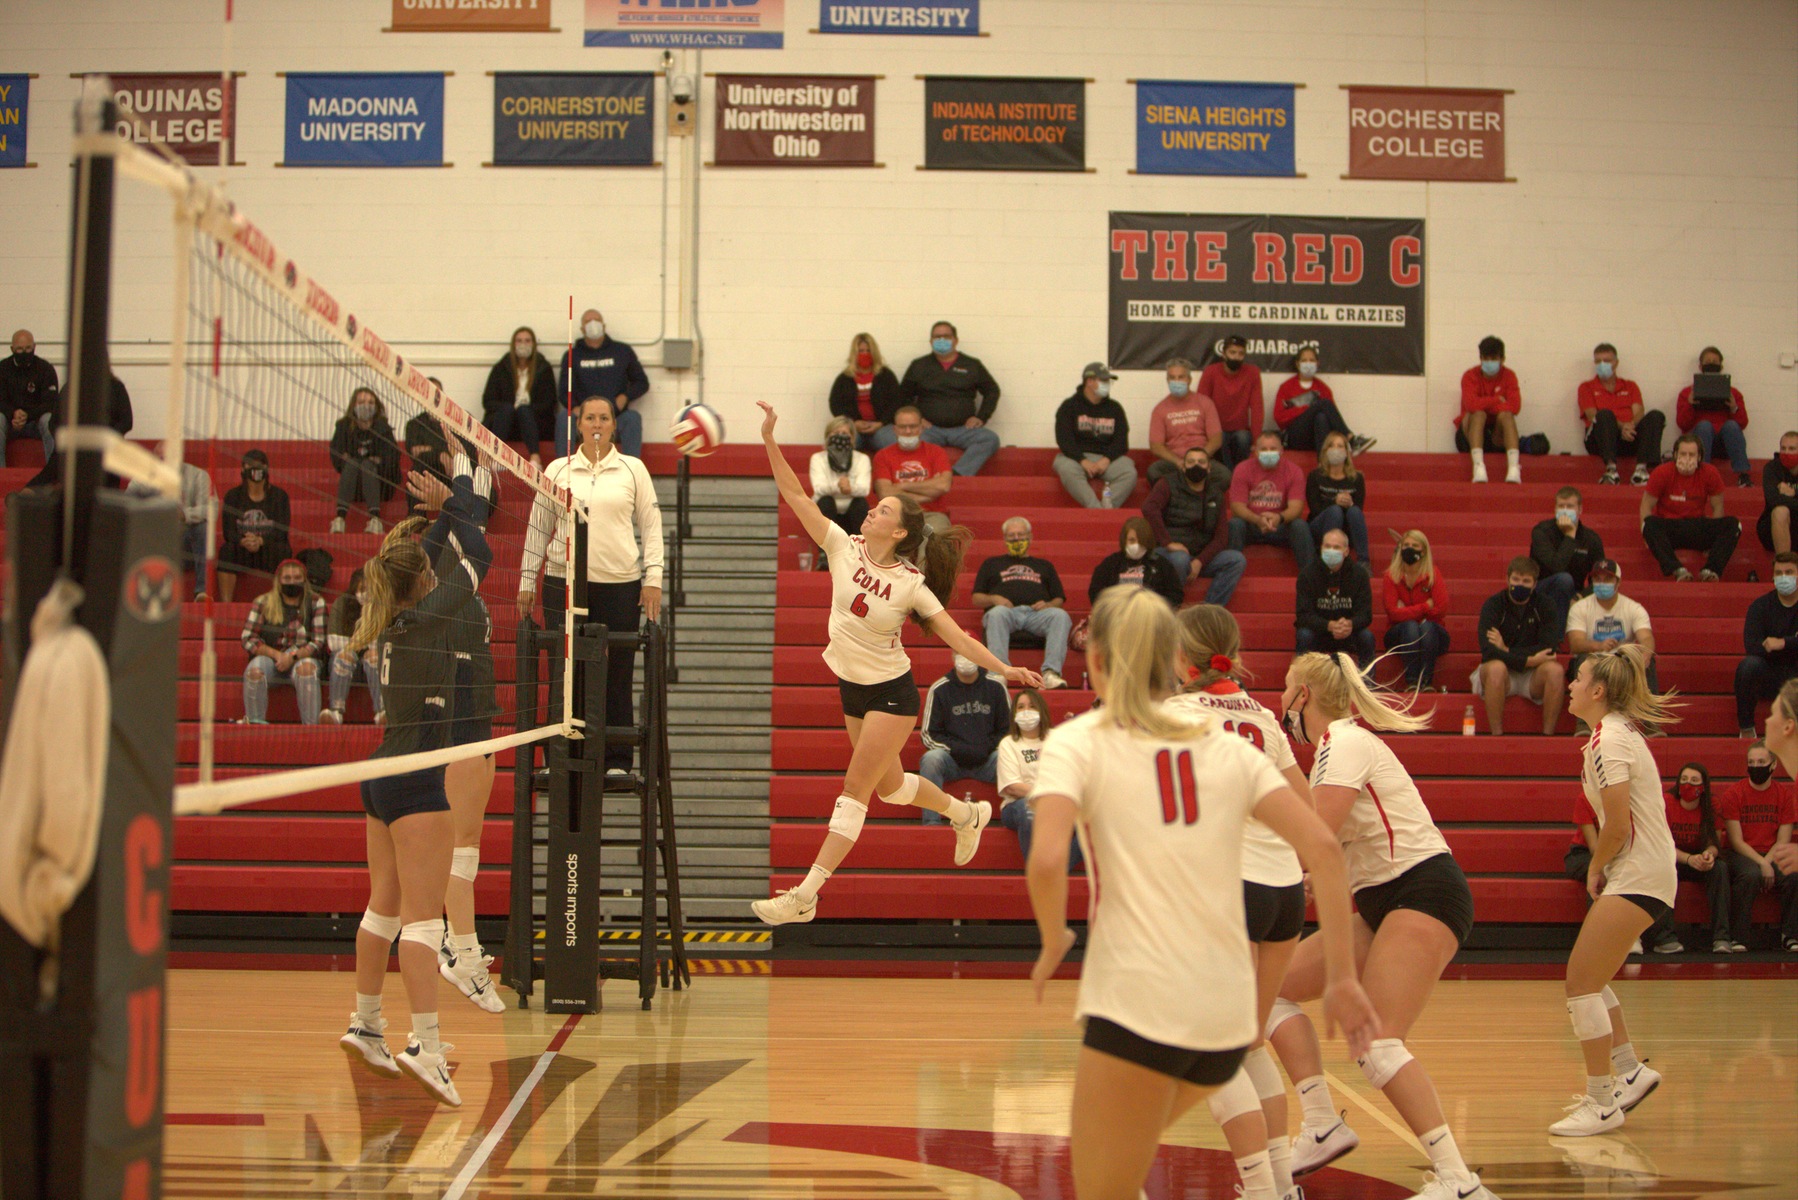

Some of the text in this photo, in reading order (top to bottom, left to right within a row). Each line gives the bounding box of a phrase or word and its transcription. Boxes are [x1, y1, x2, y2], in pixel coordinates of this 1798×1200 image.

[829, 6, 970, 28] UNIVERSITY
[629, 33, 746, 46] WWW.WHAC.NET
[113, 87, 223, 114] QUINAS
[307, 97, 418, 117] MADONNA
[501, 96, 646, 116] CORNERSTONE
[728, 83, 858, 108] University of
[724, 109, 866, 132] Northwestern
[932, 101, 1077, 122] INDIANA INSTITUTE
[1145, 105, 1287, 128] SIENA HEIGHTS
[1351, 108, 1501, 132] ROCHESTER
[116, 119, 223, 144] OLLEGE
[300, 121, 426, 142] UNIVERSITY
[517, 120, 629, 141] UNIVERSITY
[942, 123, 1068, 144] of TECHNOLOGY
[1161, 131, 1271, 152] UNIVERSITY
[773, 134, 821, 158] Ohio
[1367, 136, 1484, 160] COLLEGE
[1111, 229, 1422, 288] THE RED C
[1129, 303, 1405, 323] HOME OF THE CARDINAL CRAZIES
[852, 567, 892, 601] CUAA
[850, 592, 869, 619] 6
[1199, 696, 1263, 713] CARDINALS
[1155, 748, 1199, 826] 11
[564, 853, 579, 948] sports imports
